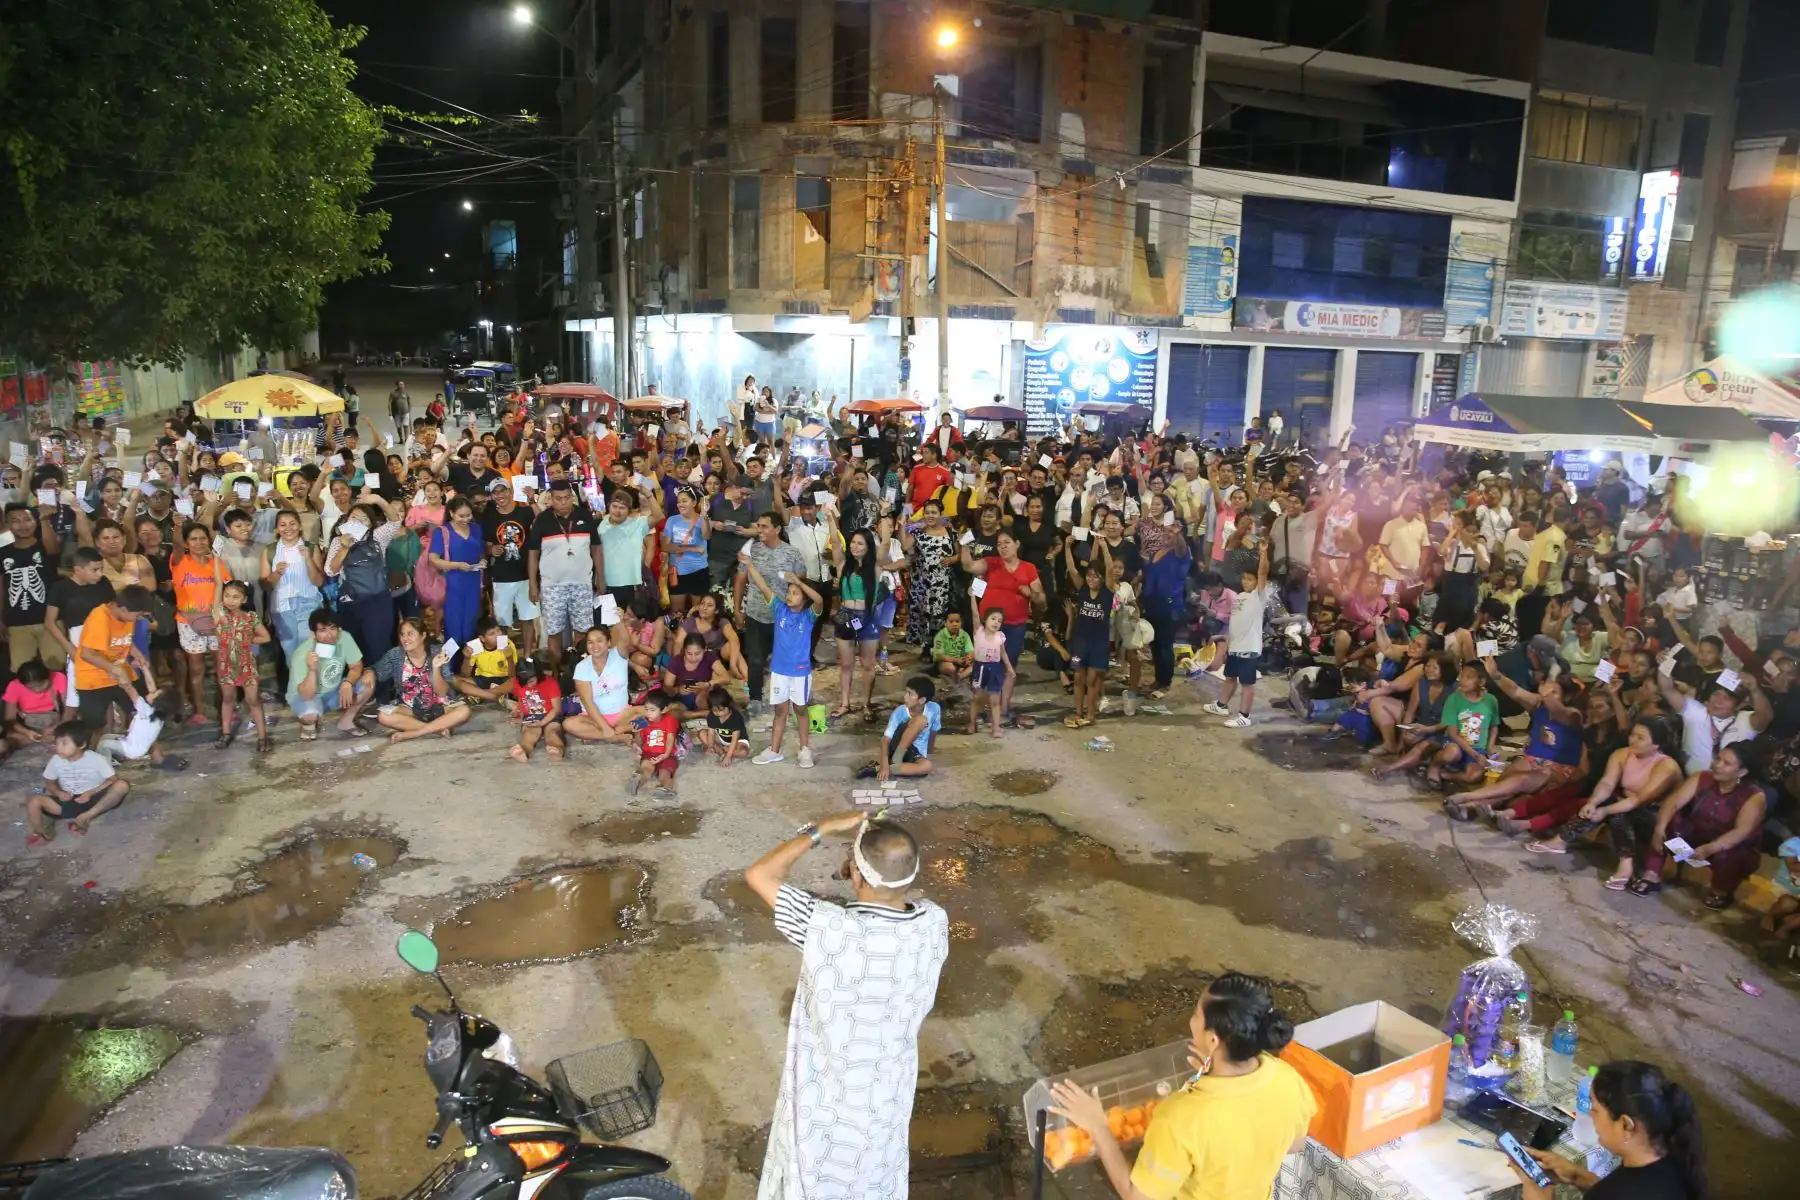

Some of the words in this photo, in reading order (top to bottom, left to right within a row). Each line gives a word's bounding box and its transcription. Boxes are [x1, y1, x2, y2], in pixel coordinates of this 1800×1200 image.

[1317, 312, 1339, 325] MIA
[1342, 313, 1378, 328] MEDIC
[1721, 383, 1758, 395] cetur
[1460, 411, 1493, 423] UCAYALI
